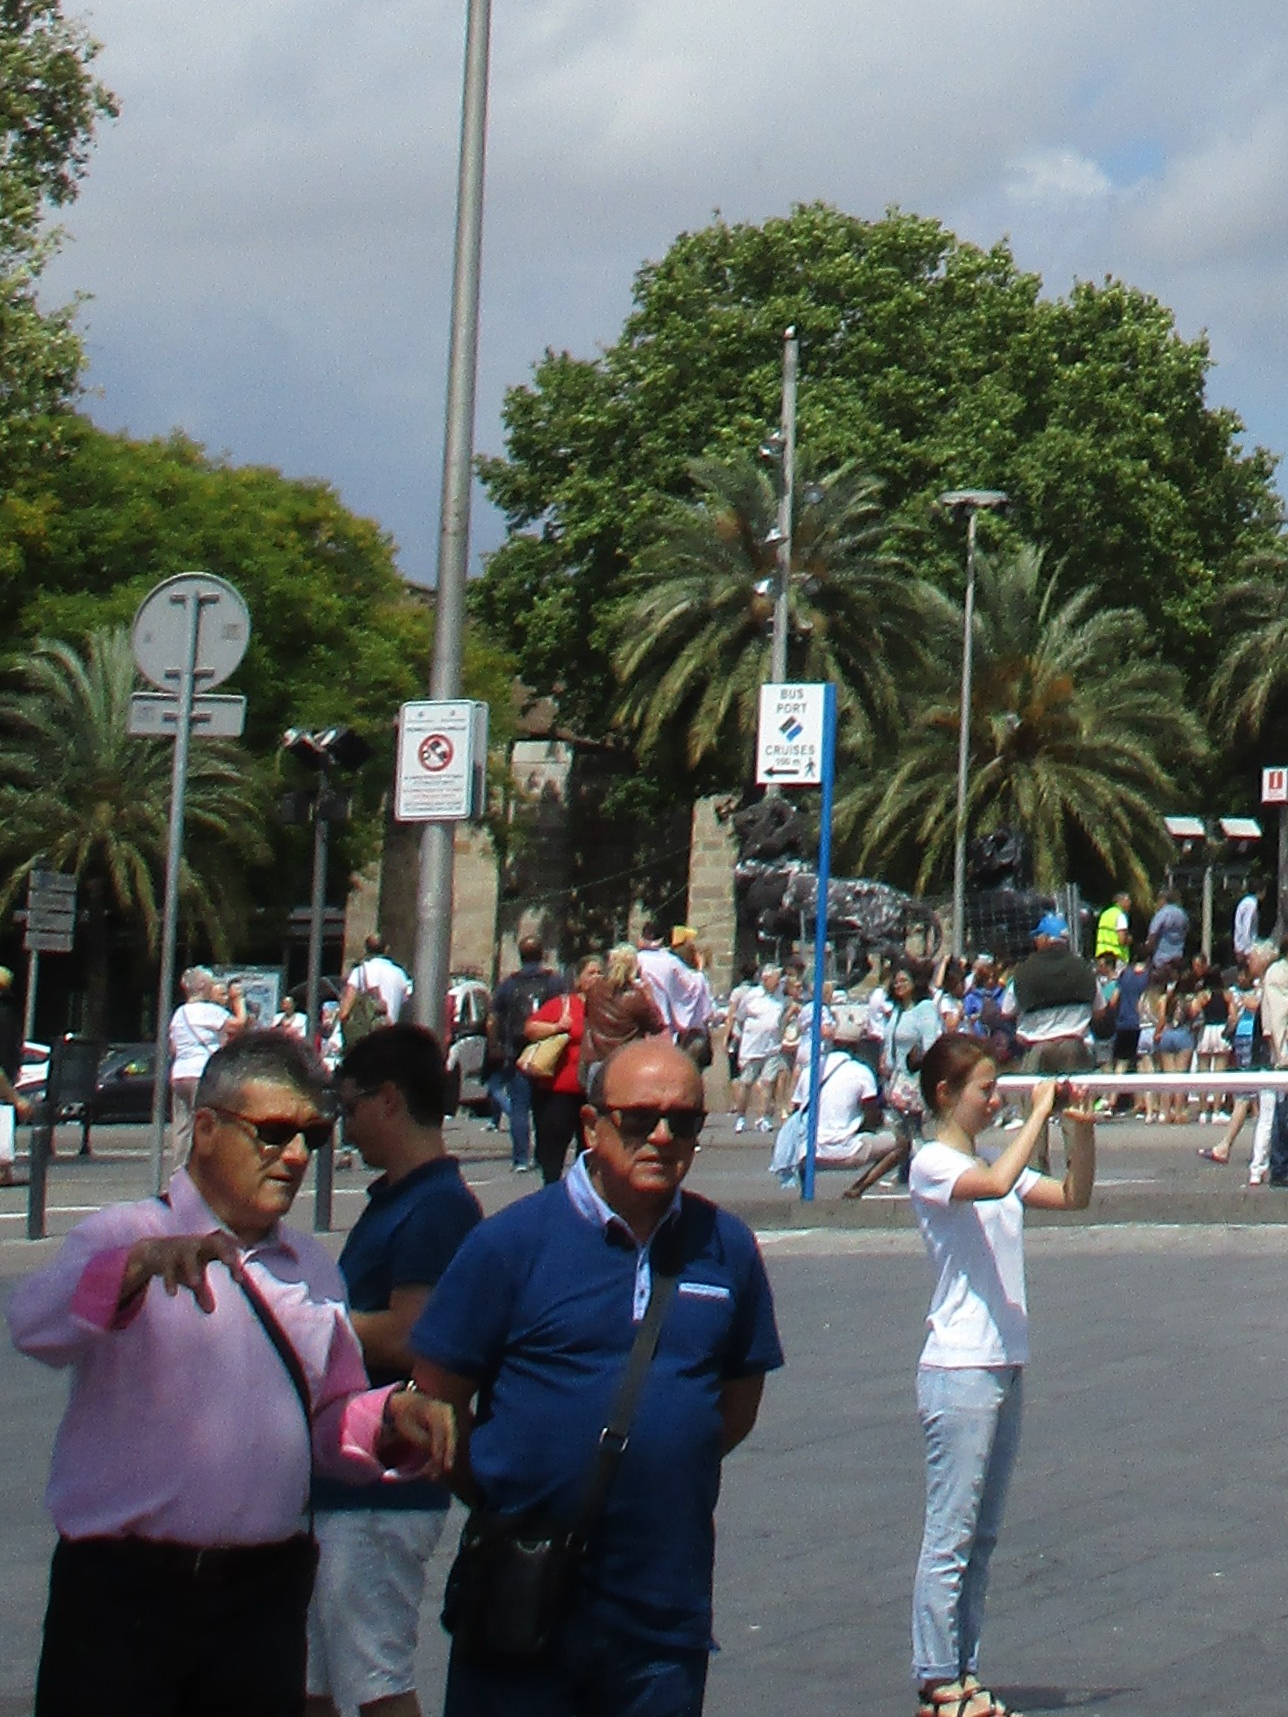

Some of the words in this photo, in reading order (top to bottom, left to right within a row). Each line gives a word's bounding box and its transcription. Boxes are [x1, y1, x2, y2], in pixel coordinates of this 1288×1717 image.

[780, 688, 804, 699] BUS
[776, 703, 807, 714] PORT
[765, 745, 815, 756] CRUISES
